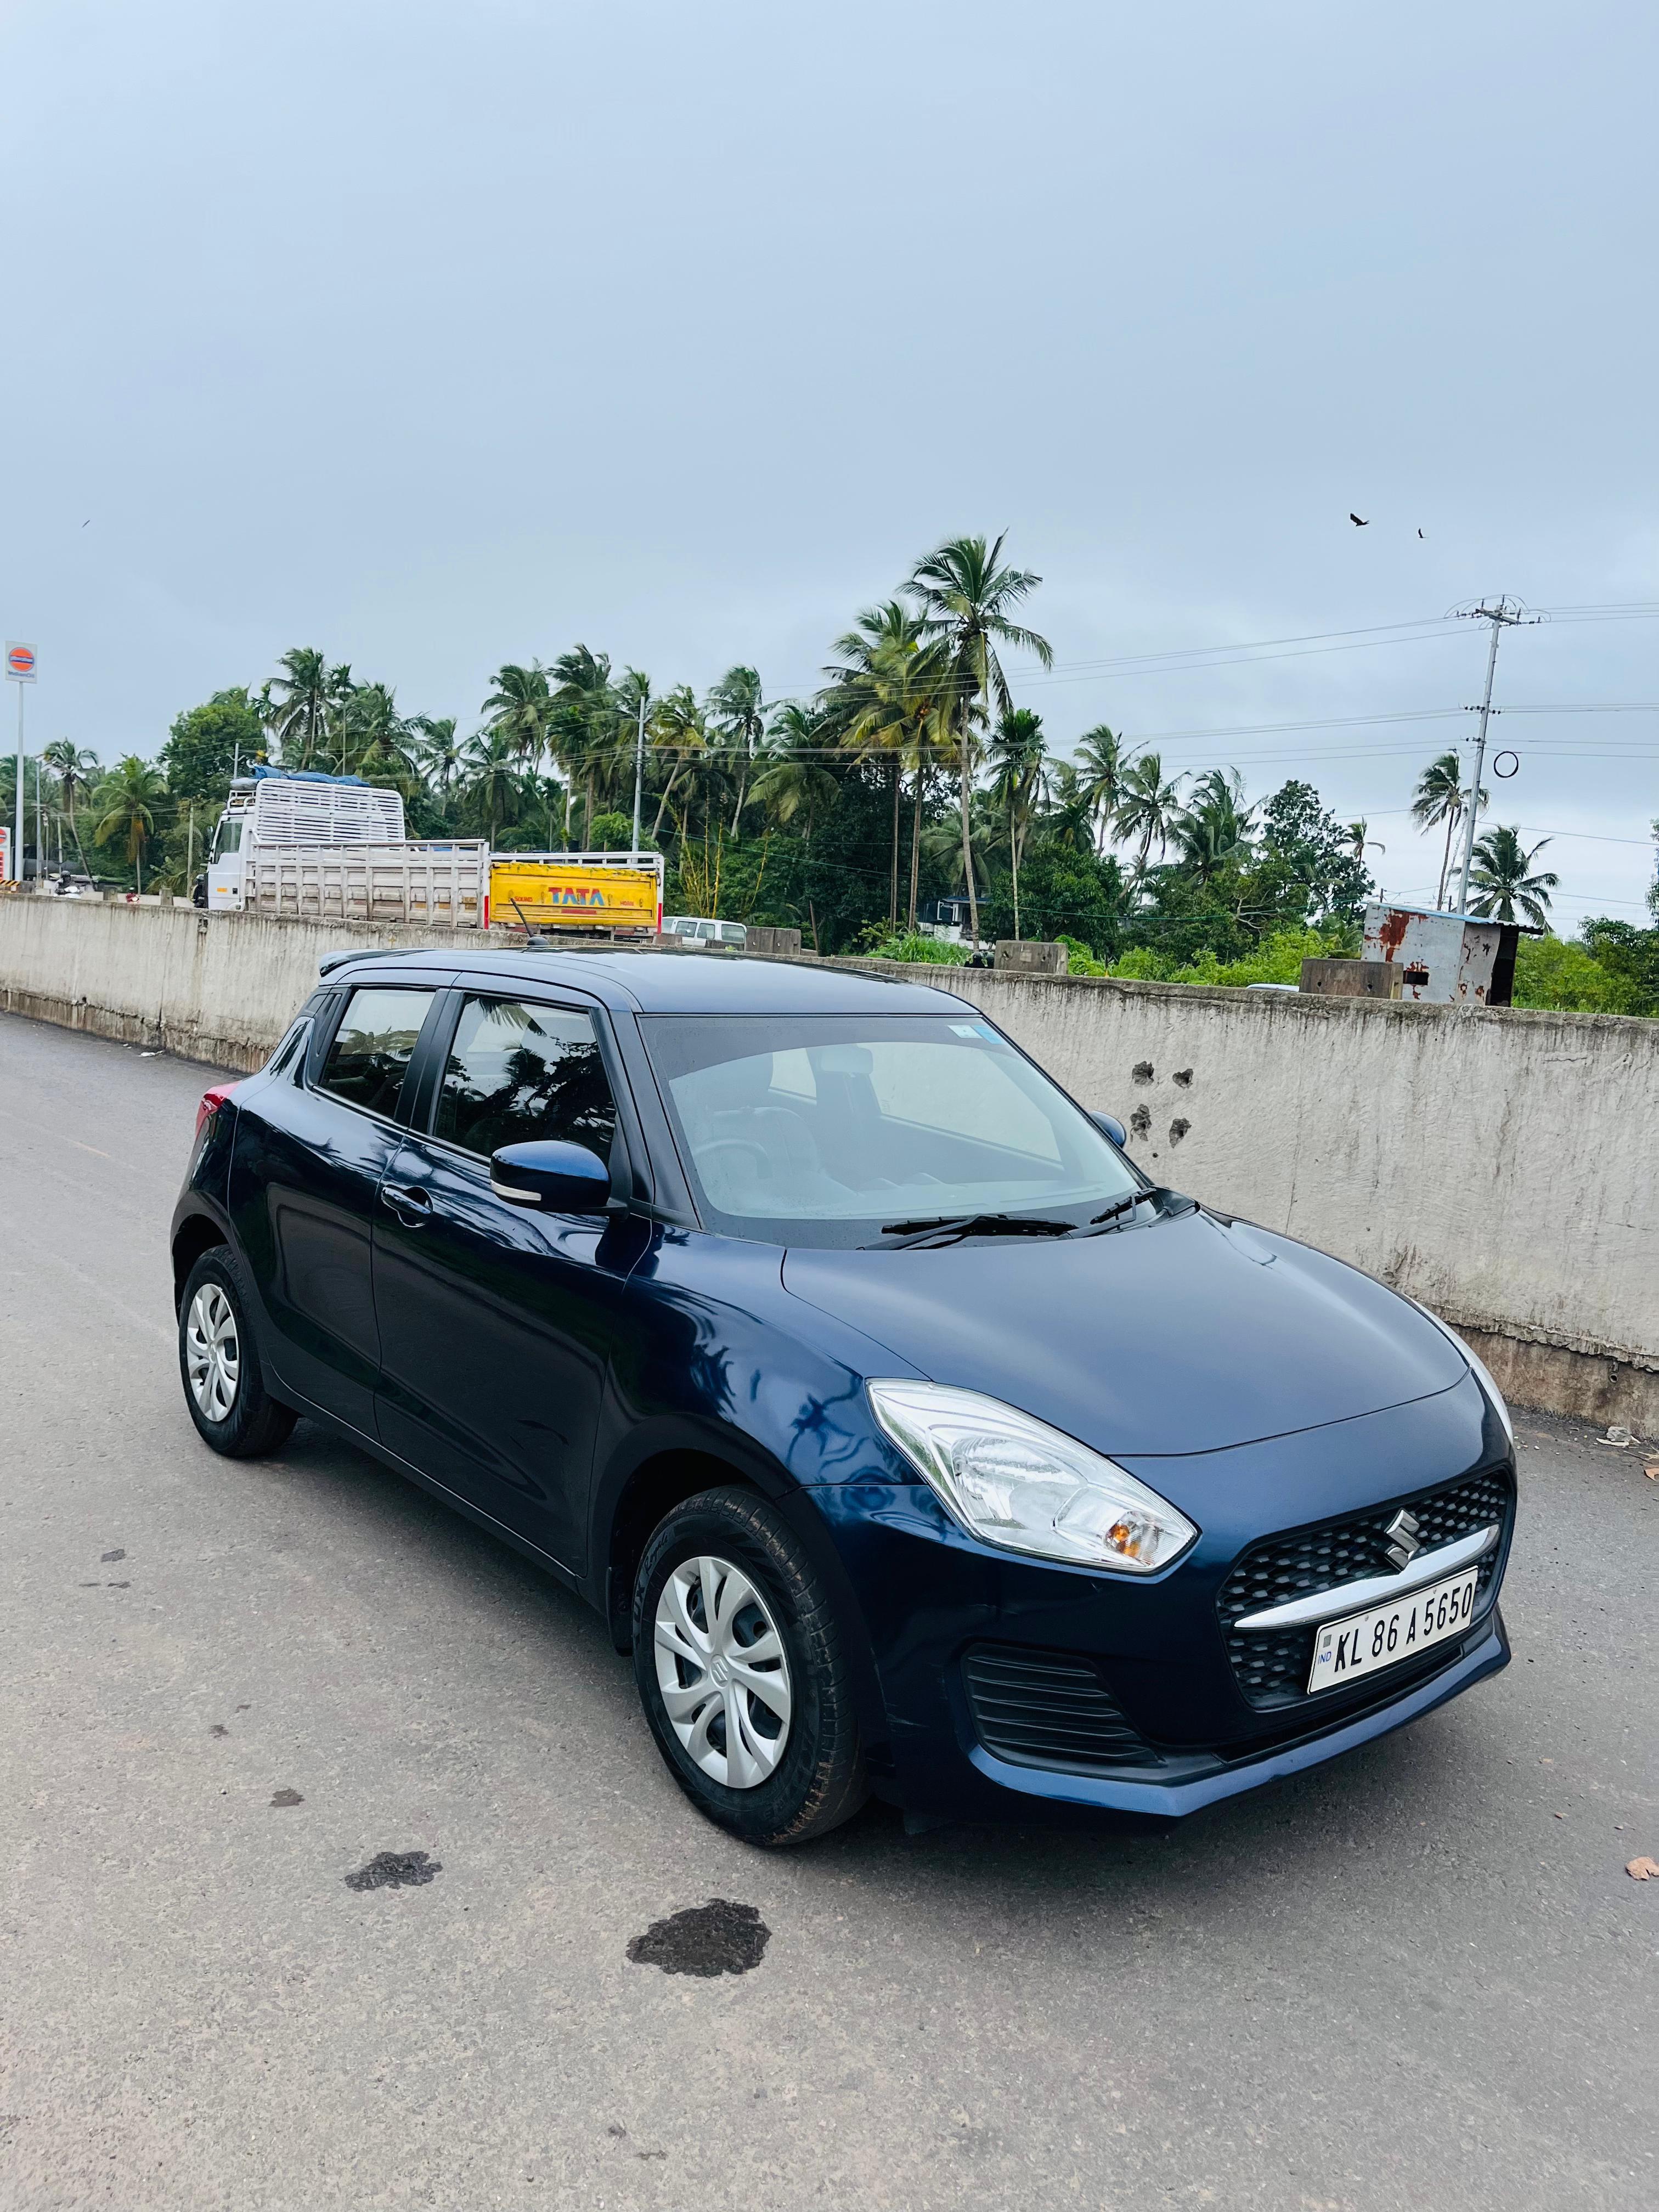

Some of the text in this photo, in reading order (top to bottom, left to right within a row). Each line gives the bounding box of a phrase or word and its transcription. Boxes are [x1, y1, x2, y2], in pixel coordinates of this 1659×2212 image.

[549, 887, 605, 905] TATA
[1334, 1582, 1473, 1673] KL 86 A 5650
[1318, 1651, 1331, 1664] IND
